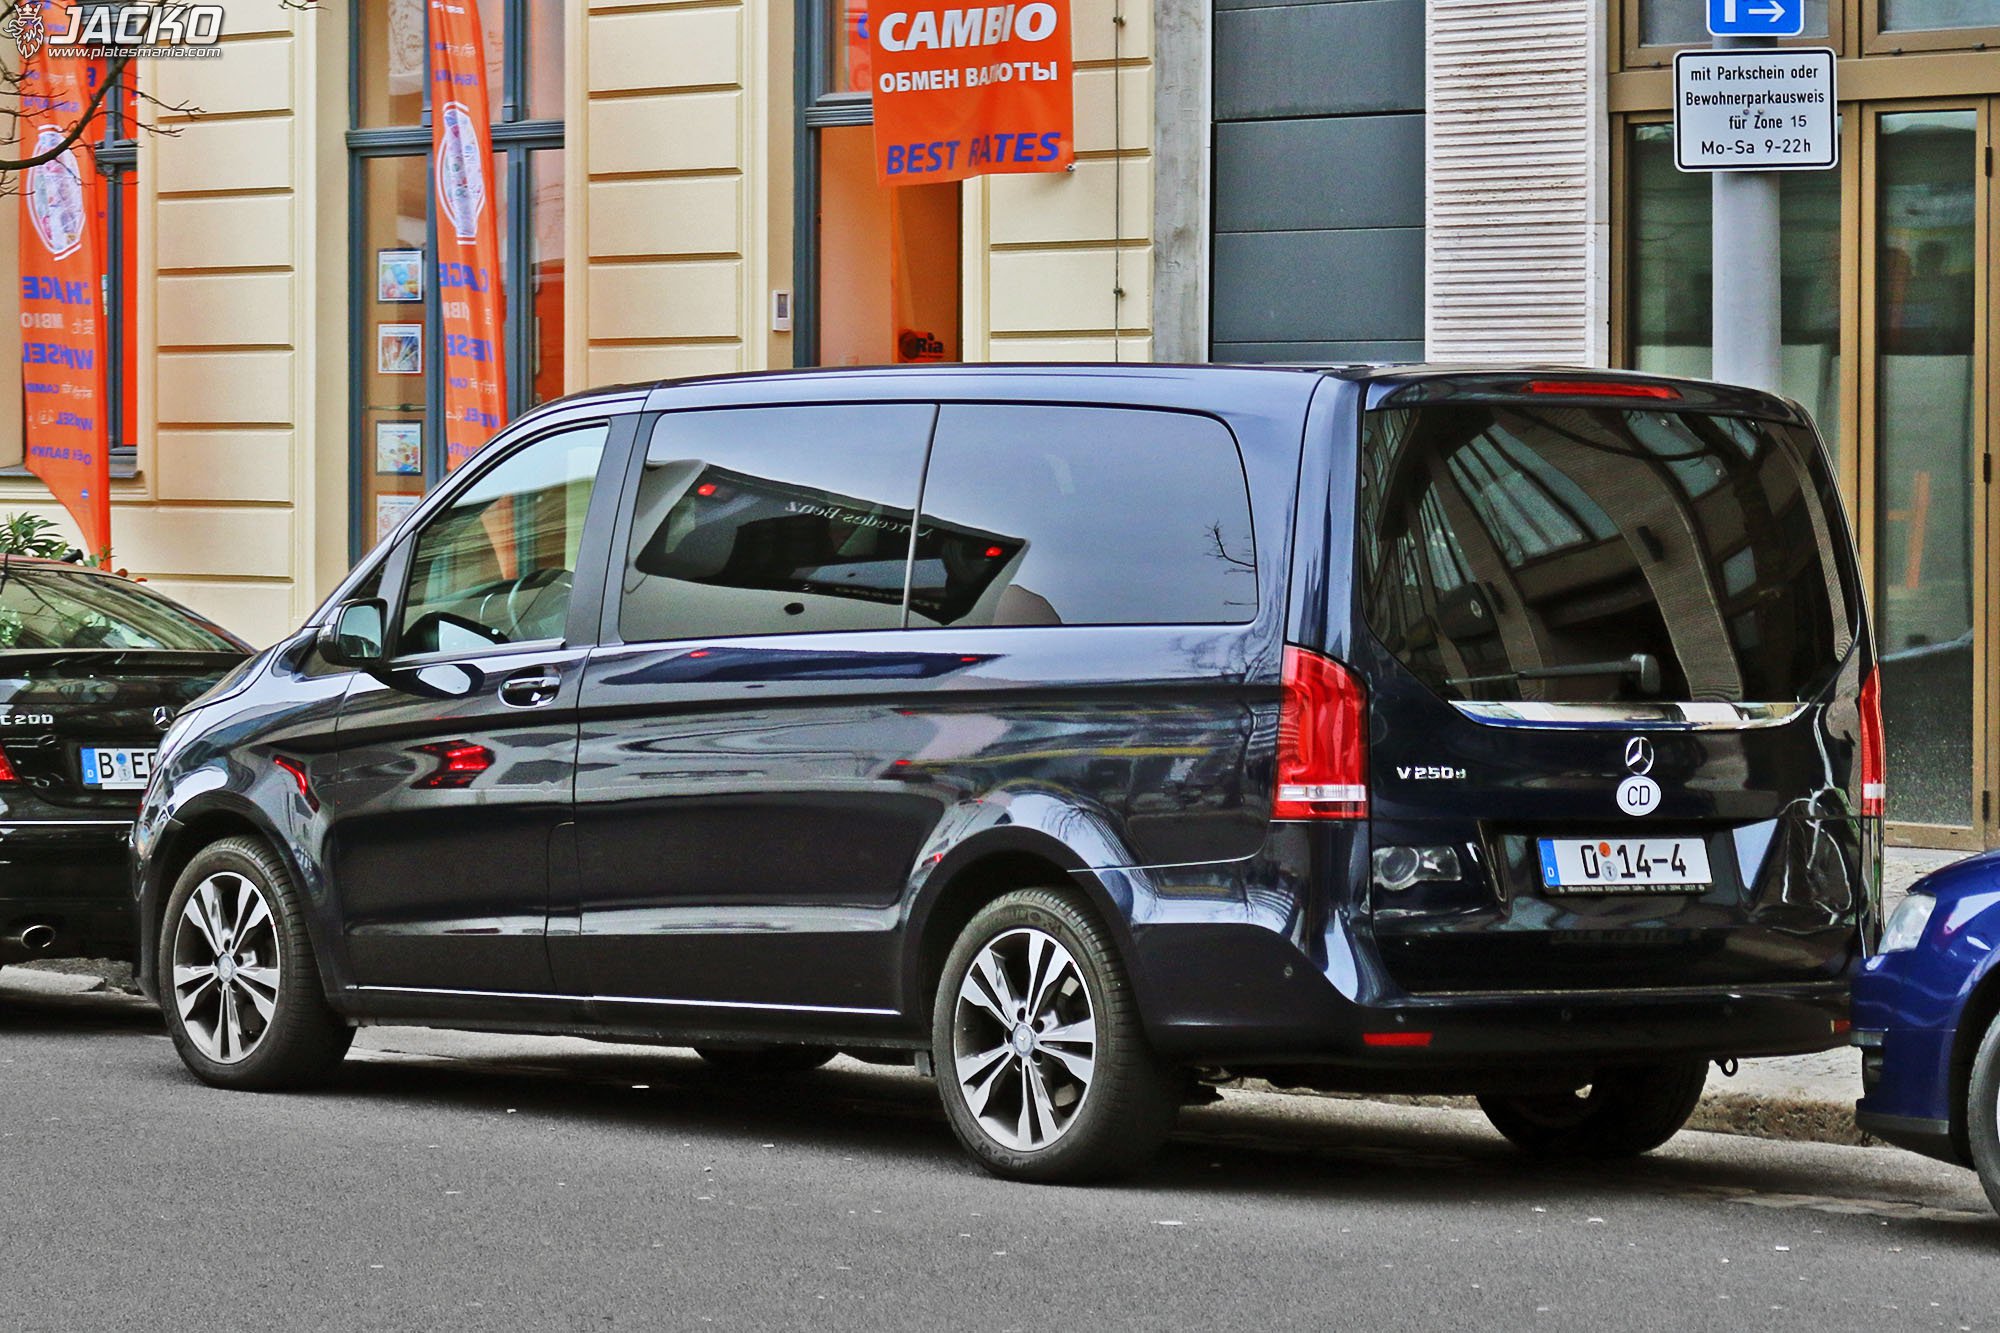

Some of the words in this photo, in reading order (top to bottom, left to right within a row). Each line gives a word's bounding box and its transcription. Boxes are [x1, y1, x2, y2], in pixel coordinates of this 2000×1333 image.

[878, 2, 1058, 52] CAMBIO
[879, 69, 959, 93] ОБМЕН
[1691, 67, 1711, 81] mit
[1717, 65, 1785, 80] Parkschein
[1791, 65, 1818, 79] oder
[1686, 89, 1825, 108] Bewohnerparkausweis
[1729, 115, 1747, 129] für
[1754, 115, 1783, 129] Zone
[1790, 115, 1807, 128] 15
[886, 140, 961, 175] BEST
[968, 132, 1061, 167] RATES
[1701, 140, 1755, 155] Mo-Sa
[1764, 139, 1811, 153] 9-22h
[916, 332, 944, 353] Ria
[15, 714, 54, 725] 200
[87, 769, 94, 778] D
[99, 752, 114, 779] B
[1396, 766, 1412, 780] V
[1627, 785, 1651, 806] CD
[1547, 867, 1555, 877] D
[1616, 844, 1686, 879] 14-4
